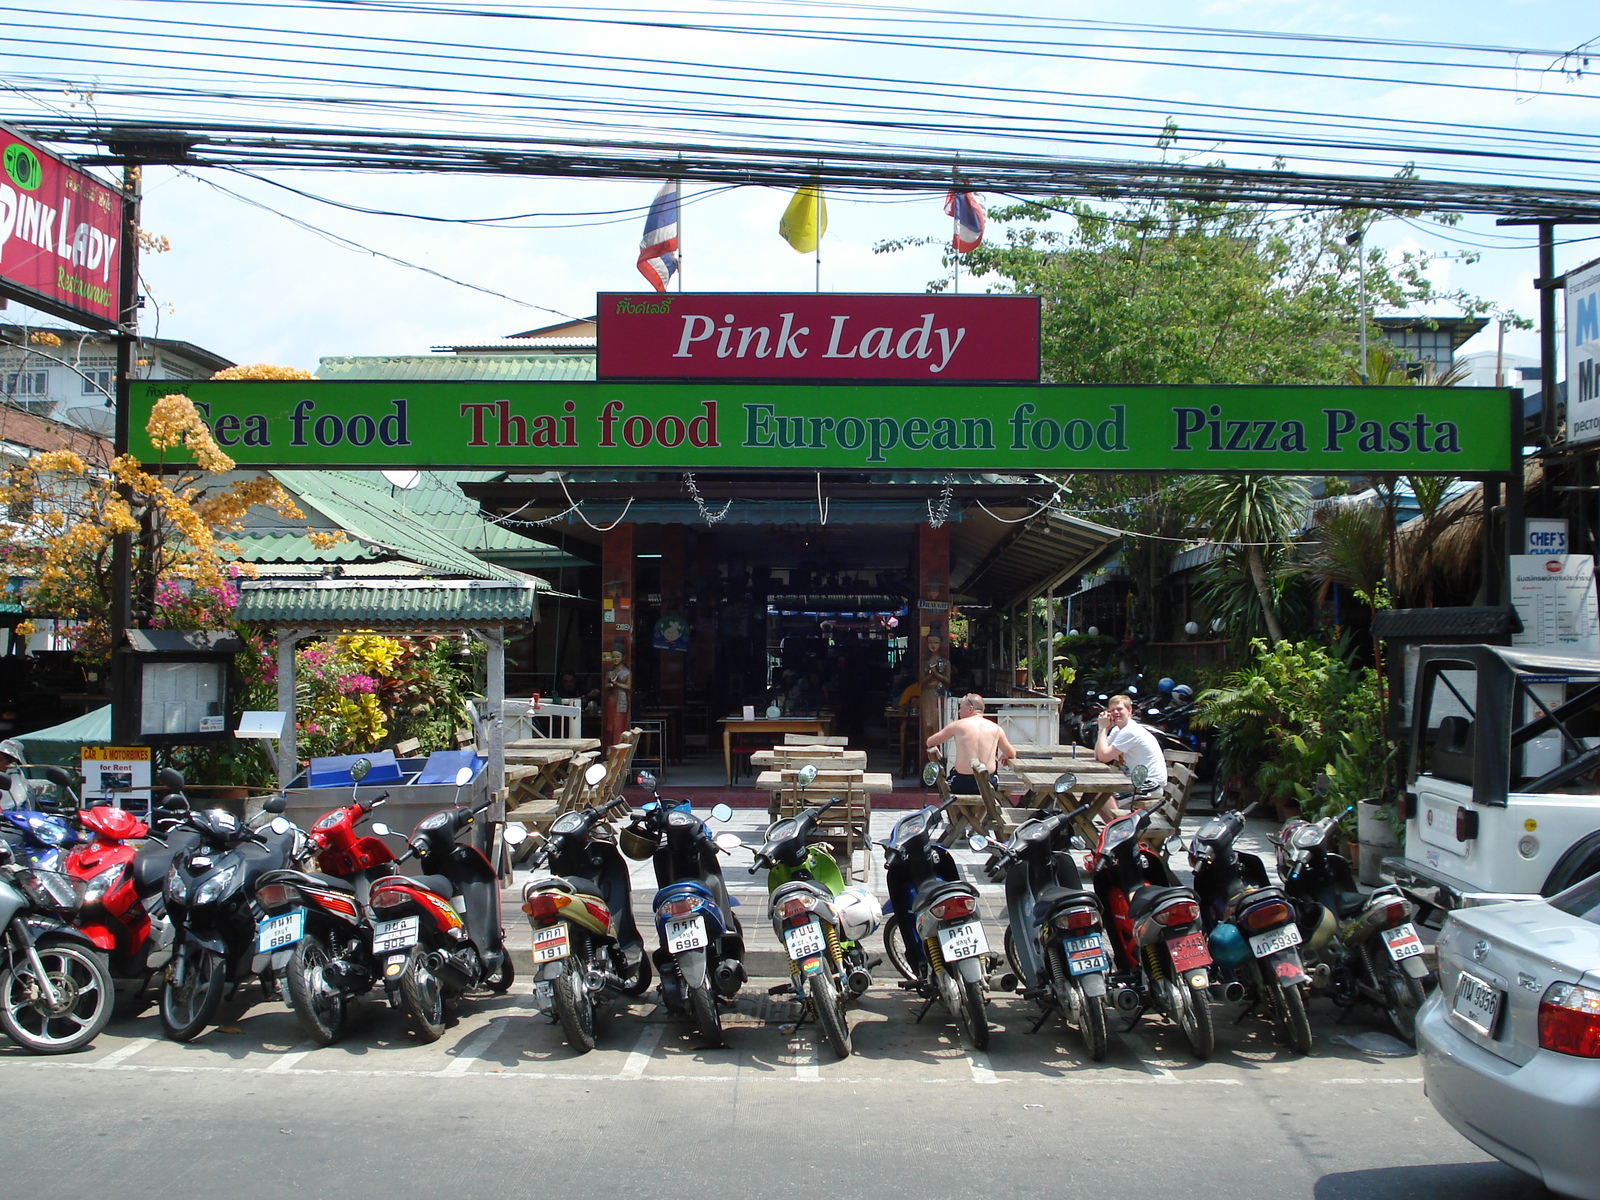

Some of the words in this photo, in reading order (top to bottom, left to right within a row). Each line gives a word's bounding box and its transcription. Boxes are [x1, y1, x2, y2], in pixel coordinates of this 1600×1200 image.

[0, 182, 56, 264] PINK
[58, 197, 117, 284] LADY
[56, 265, 113, 309] Restaurant
[672, 312, 810, 359] Pink
[821, 312, 966, 373] Lady
[288, 399, 412, 447] food
[459, 399, 580, 448] Thai
[597, 399, 722, 449] food
[1171, 404, 1309, 452] Pizza
[1321, 408, 1463, 454] Pasta
[1573, 416, 1600, 437] ресто
[741, 402, 997, 463] European
[1008, 401, 1130, 452] food
[1529, 531, 1566, 547] CHEF'S
[83, 749, 97, 760] CAR
[102, 749, 108, 760] &
[109, 749, 149, 760] MOTORBIKES
[270, 933, 292, 947] 699
[383, 938, 406, 950] 902
[676, 938, 700, 950] 698
[540, 947, 562, 960] 191
[795, 943, 819, 957] 263
[954, 945, 978, 958] 587
[1395, 944, 1420, 958] 849
[1077, 958, 1101, 971] 134
[1473, 986, 1498, 1015] 9356
